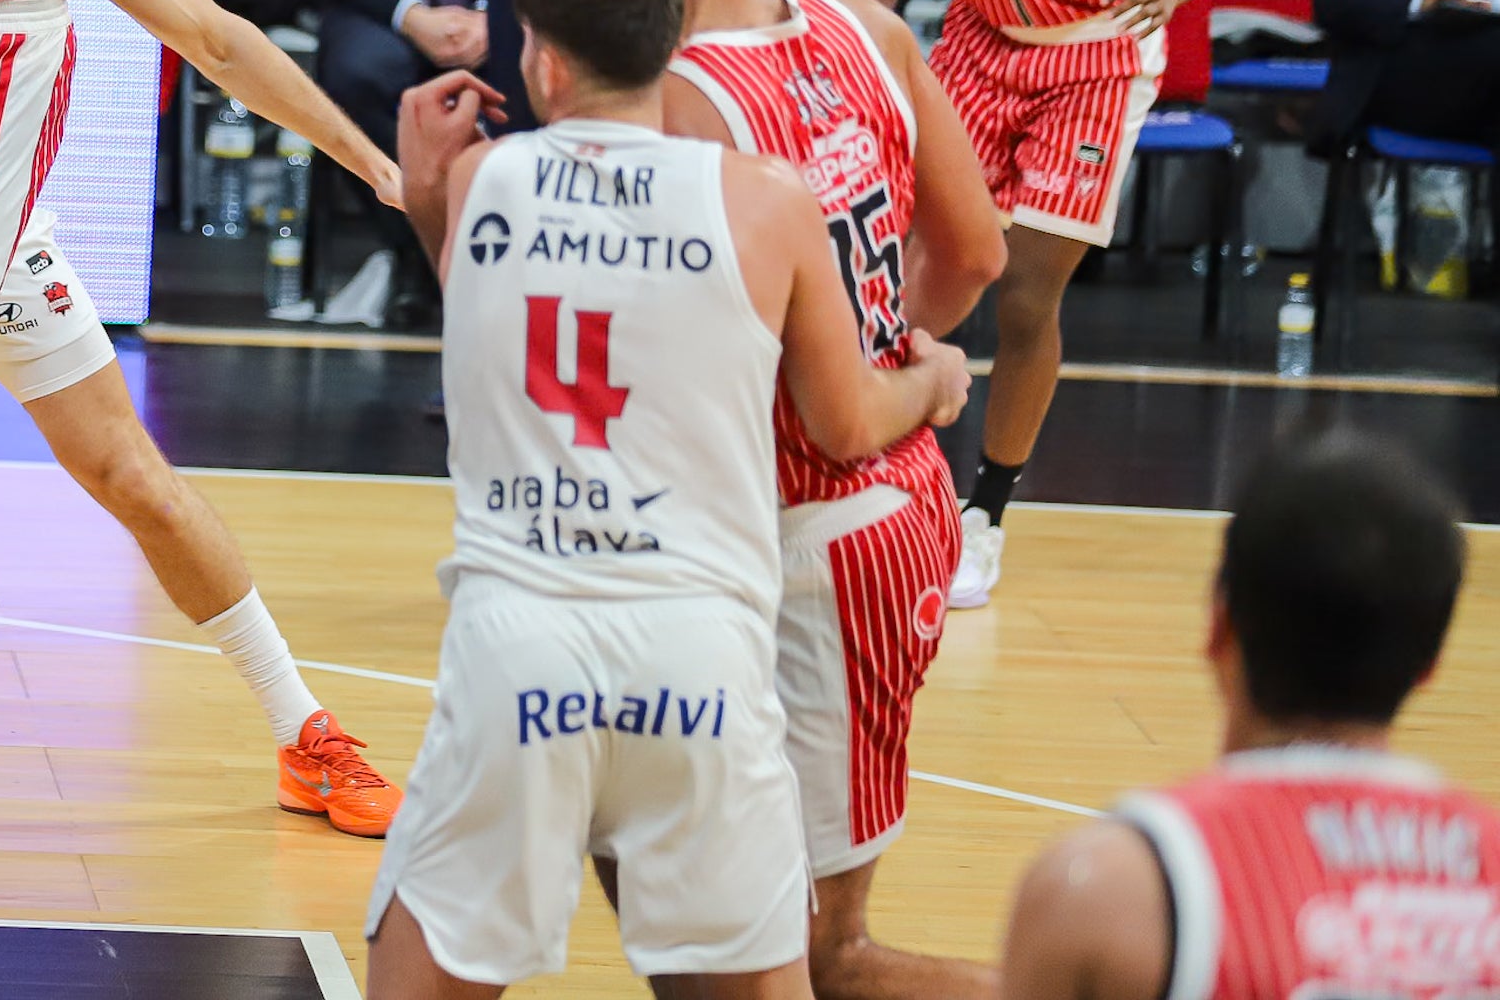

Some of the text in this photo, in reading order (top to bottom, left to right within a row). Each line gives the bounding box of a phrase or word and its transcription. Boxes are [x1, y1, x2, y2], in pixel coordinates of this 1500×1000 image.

[534, 156, 654, 207] VILLAR
[31, 257, 51, 275] acb
[526, 228, 713, 273] AMUTIO
[524, 294, 631, 451] 4
[487, 465, 610, 512] araba
